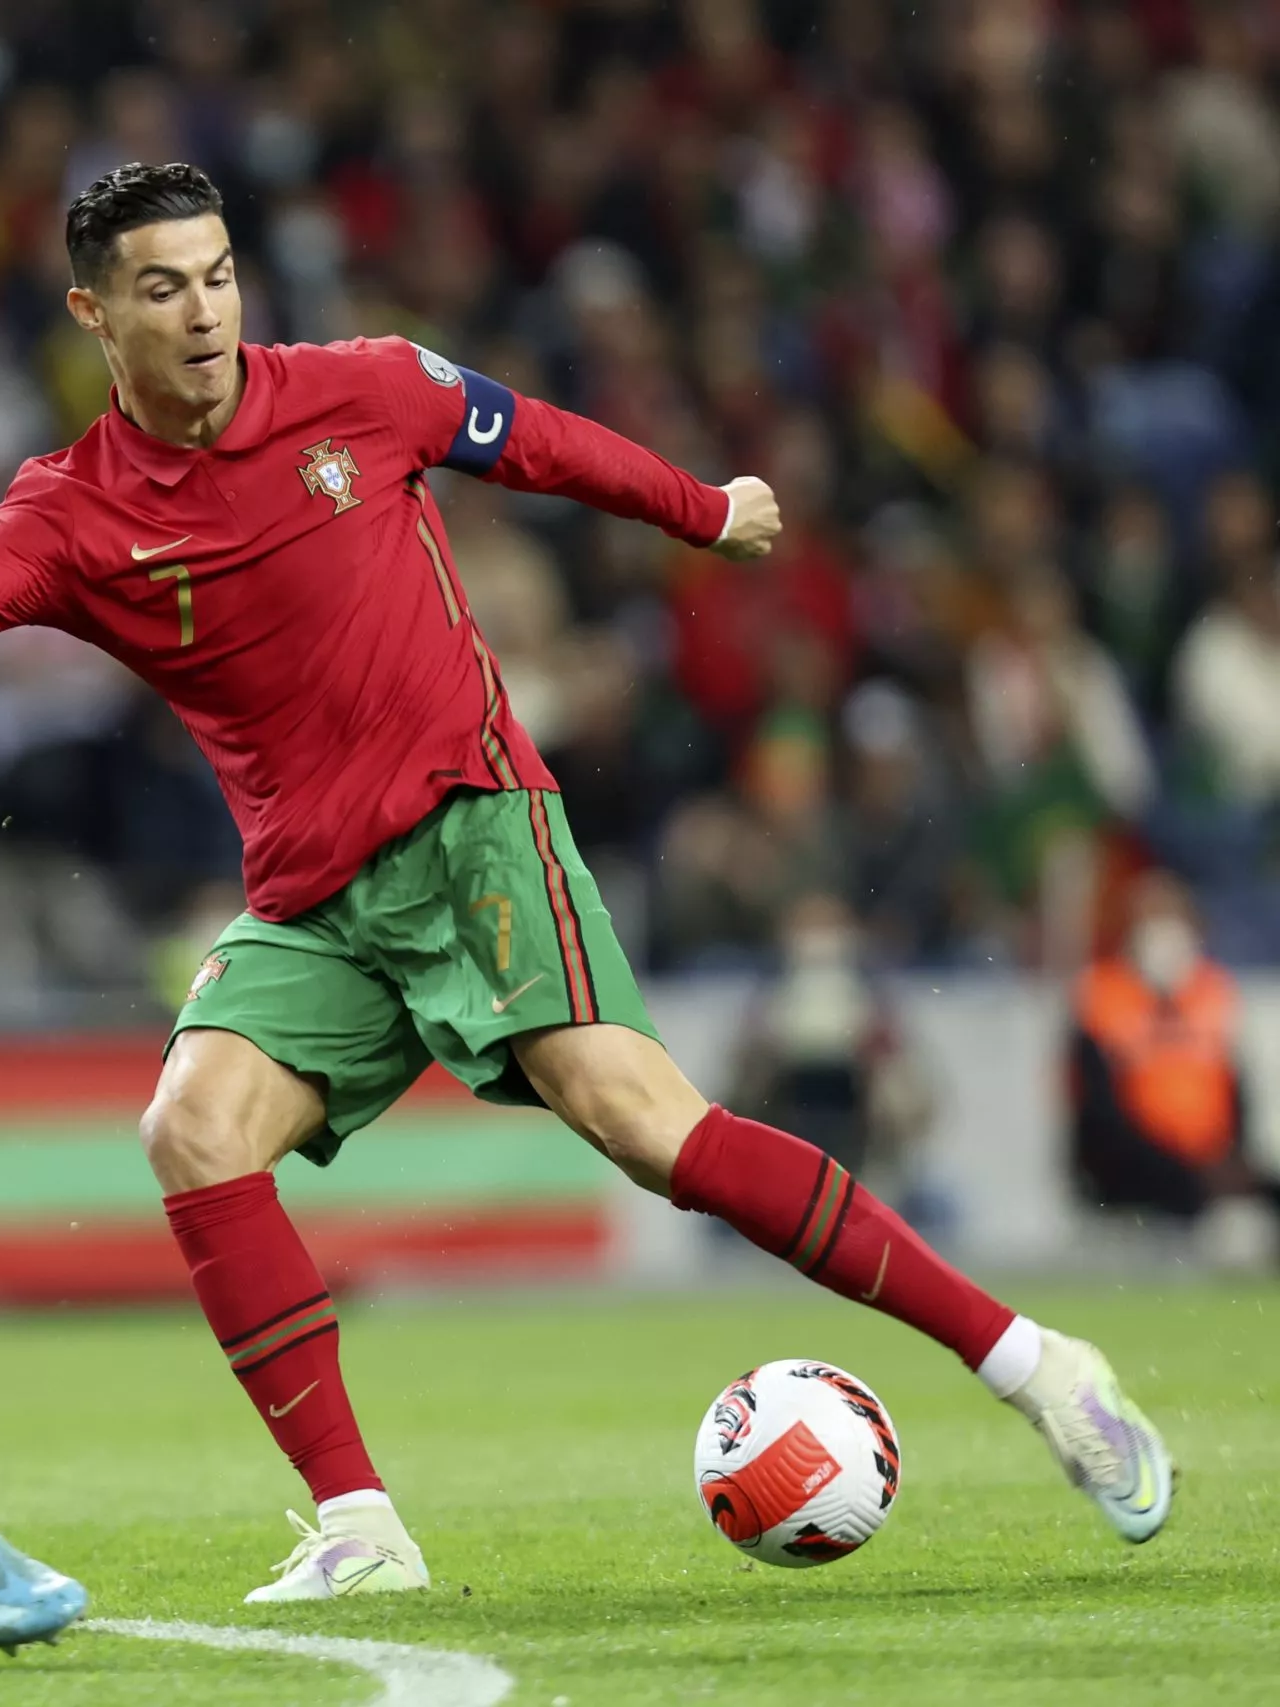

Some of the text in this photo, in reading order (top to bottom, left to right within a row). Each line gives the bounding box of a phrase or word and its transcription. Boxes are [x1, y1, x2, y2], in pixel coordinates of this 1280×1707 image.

[468, 406, 503, 444] C
[149, 564, 194, 647] 7
[468, 892, 511, 971] 7
